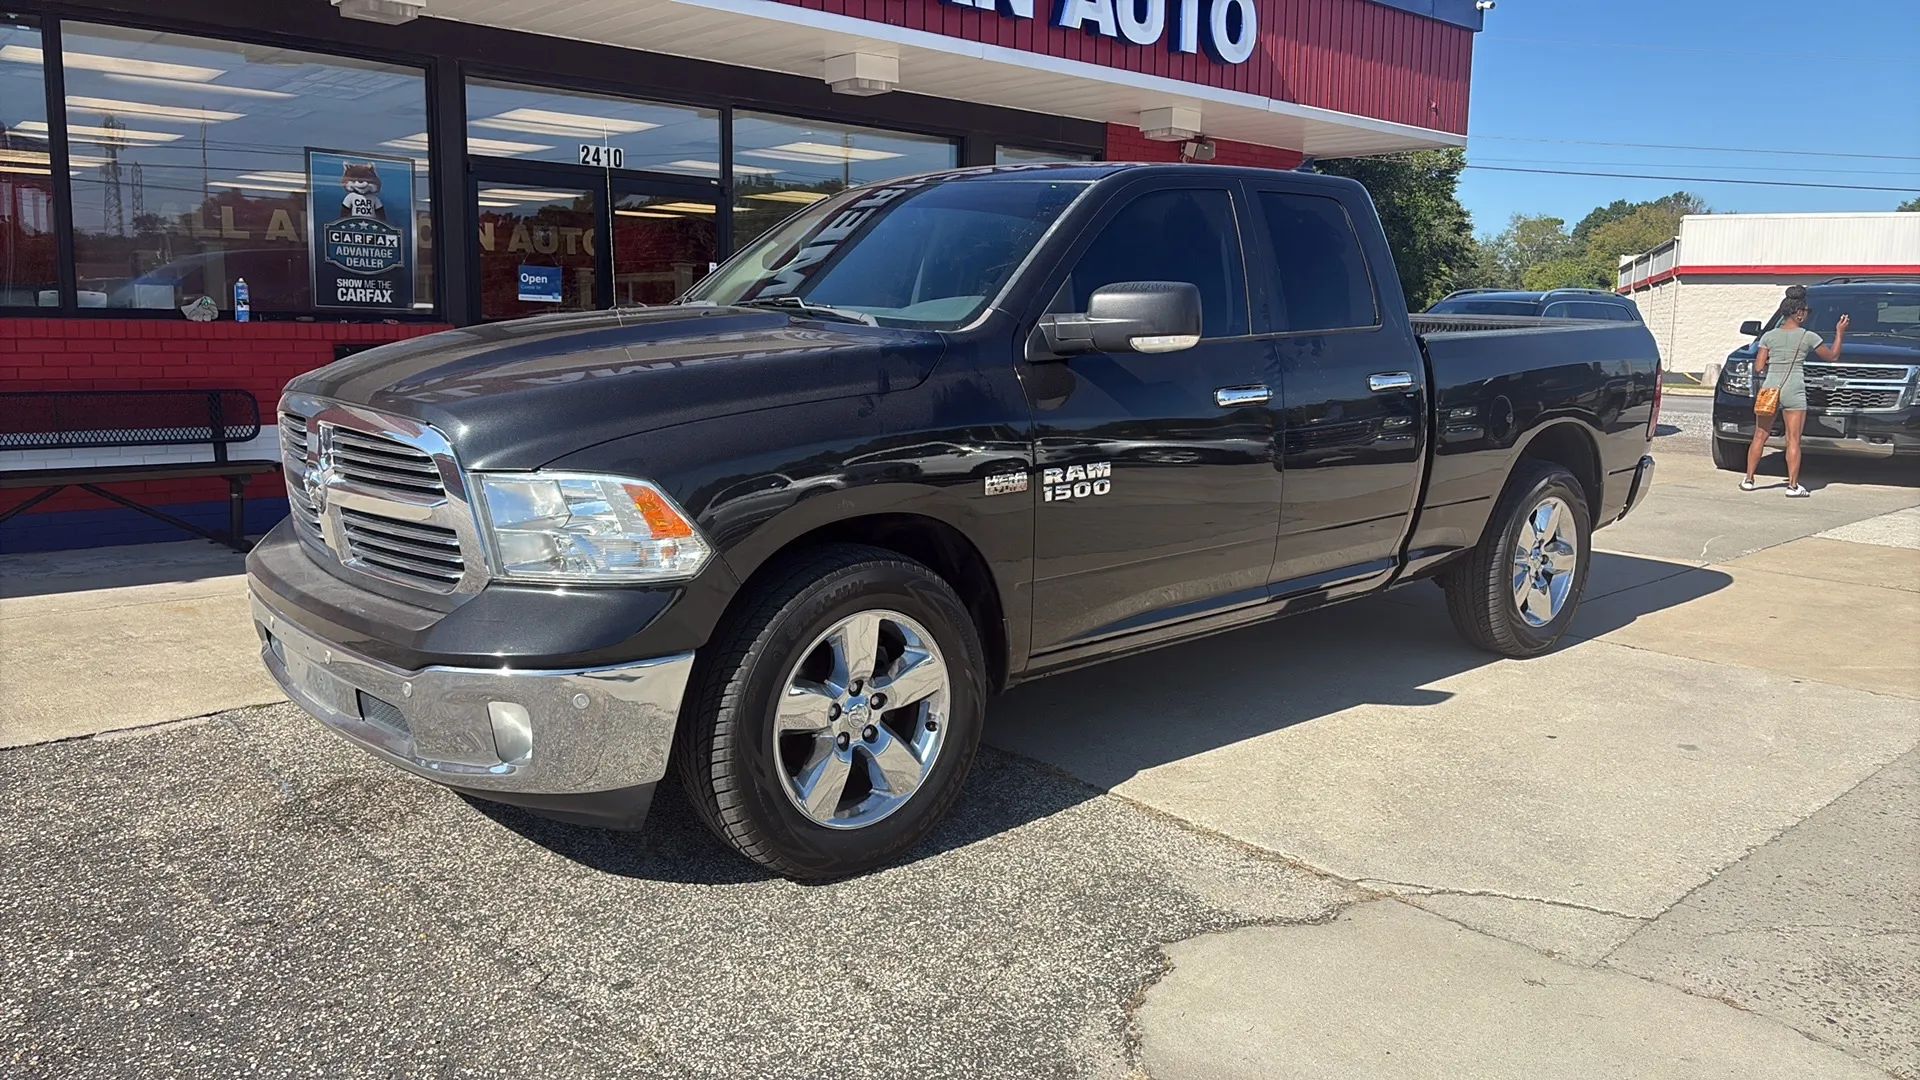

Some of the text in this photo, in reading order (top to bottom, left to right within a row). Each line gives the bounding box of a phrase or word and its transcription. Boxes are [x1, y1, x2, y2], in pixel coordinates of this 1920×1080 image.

[581, 145, 622, 168] 2410
[354, 199, 372, 207] CAR
[355, 206, 373, 215] FOX
[331, 232, 398, 248] CARFAX
[336, 245, 393, 259] ADVANTAGE
[346, 257, 384, 268] DEALER
[336, 278, 392, 290] SHOW ME THE
[520, 273, 548, 285] Open
[337, 287, 392, 303] CARFAX
[1043, 462, 1111, 485] RAM
[1043, 479, 1111, 502] 1500
